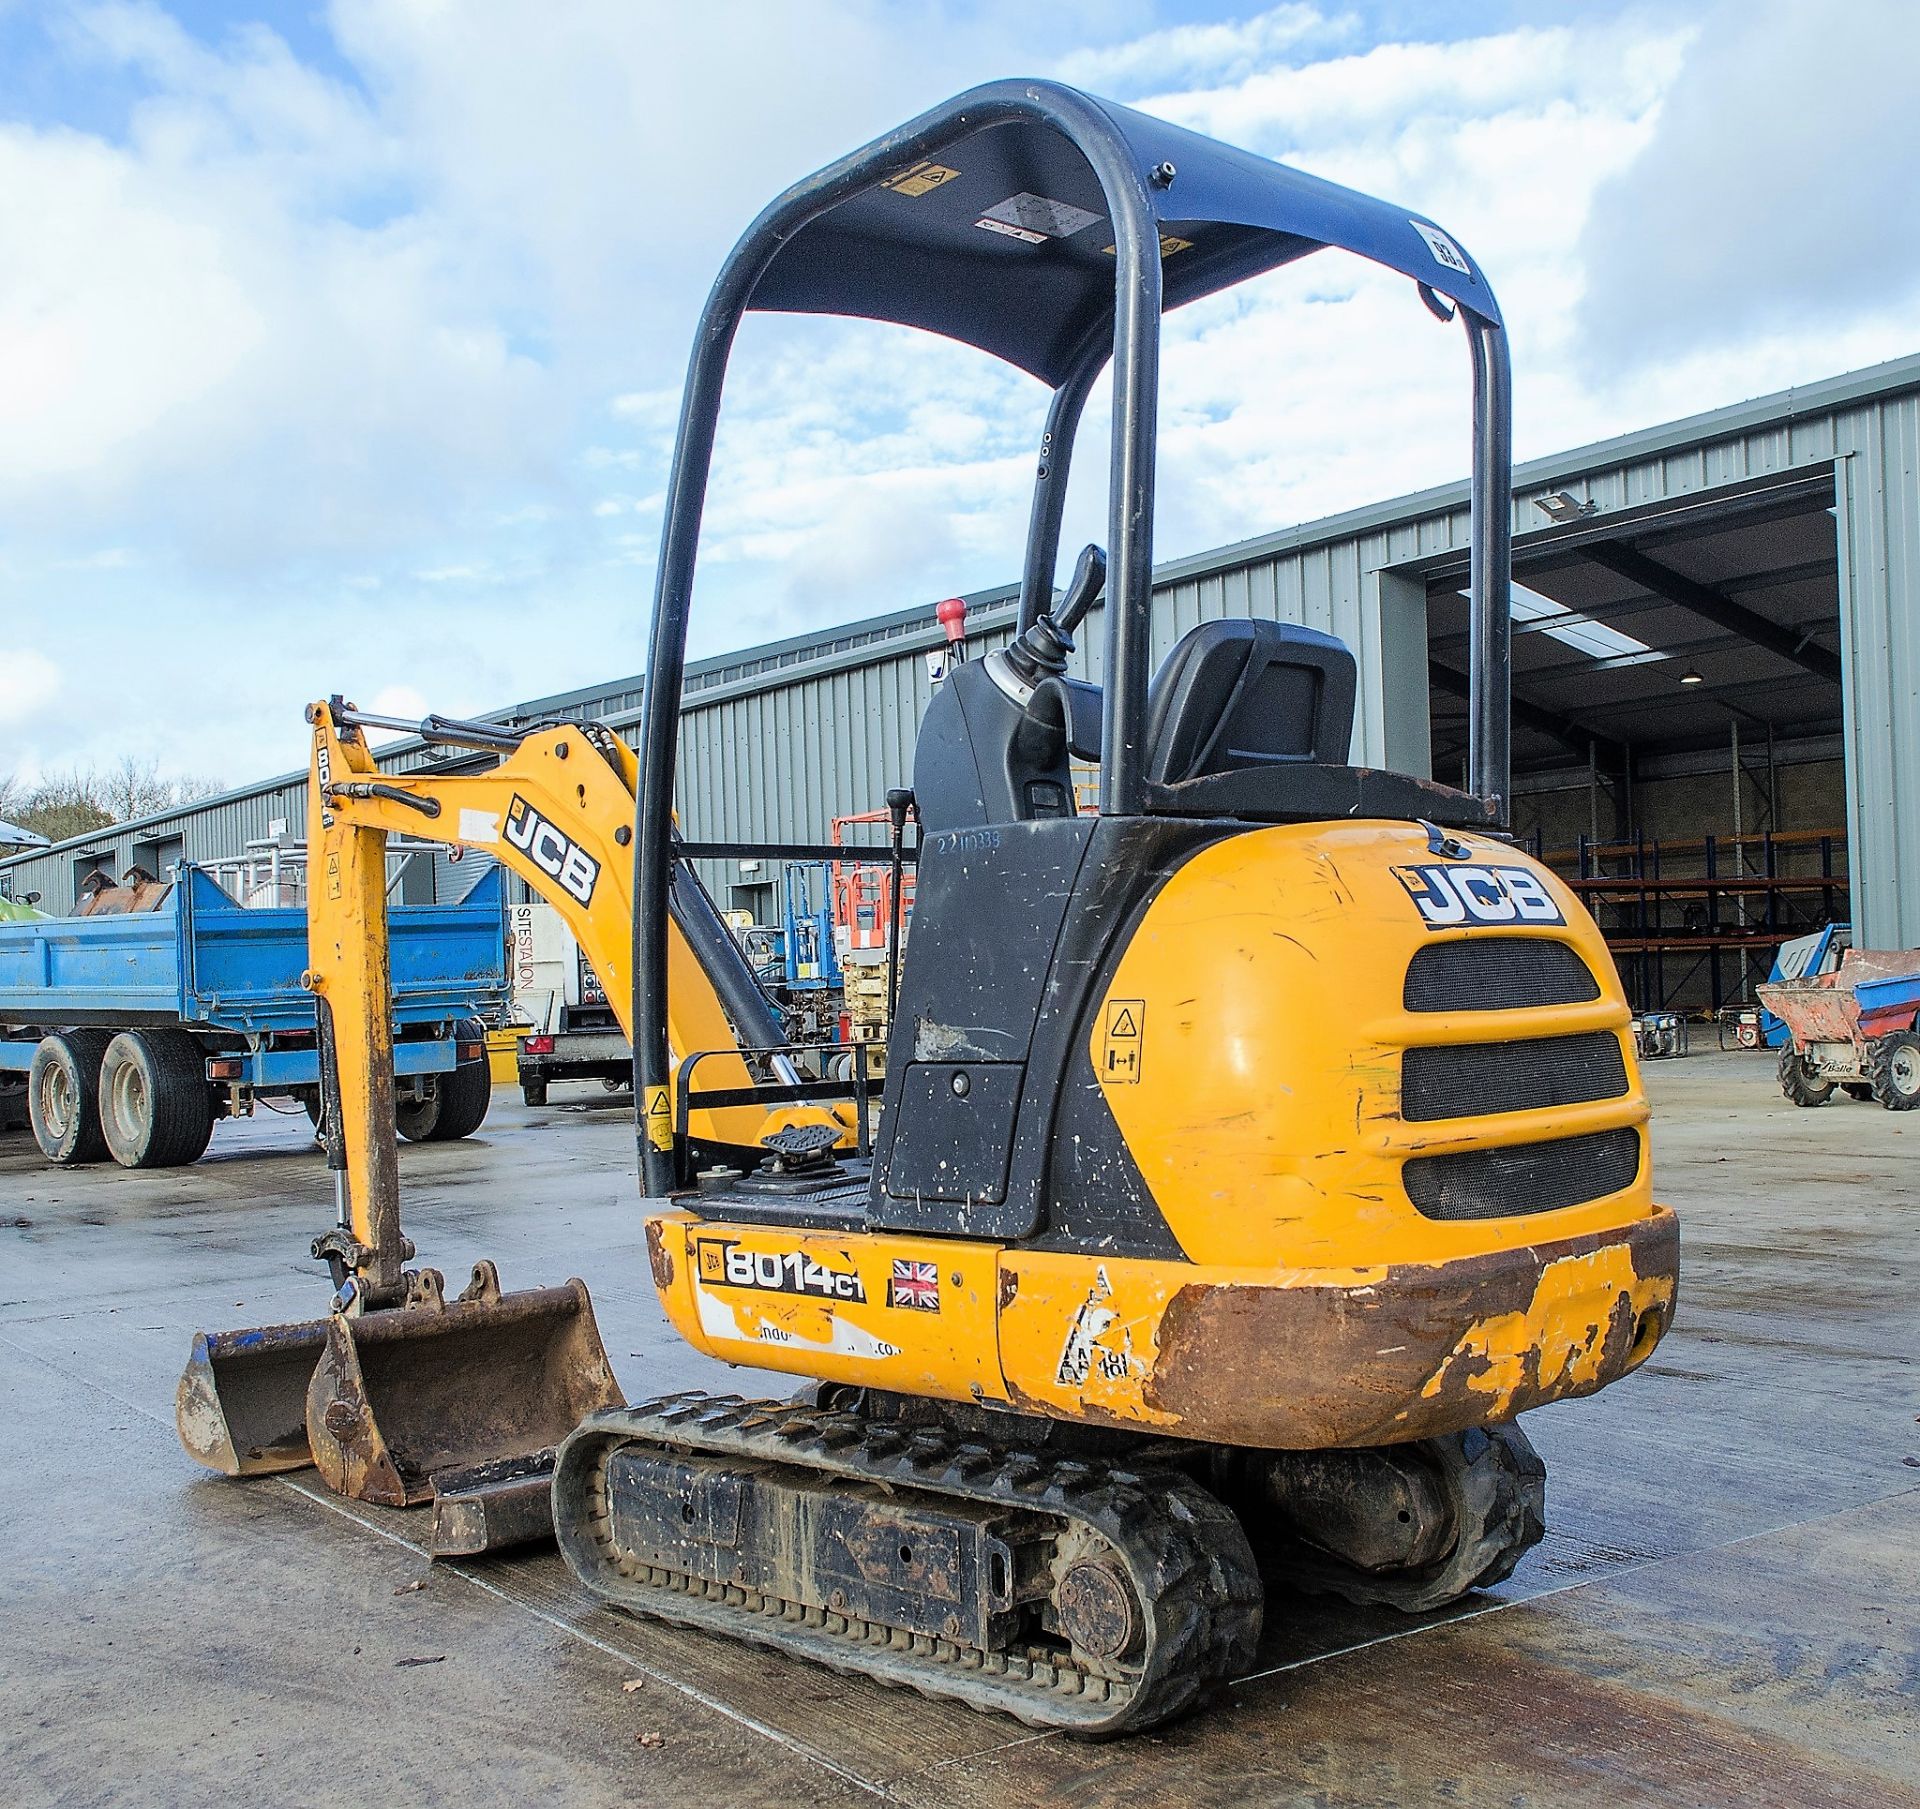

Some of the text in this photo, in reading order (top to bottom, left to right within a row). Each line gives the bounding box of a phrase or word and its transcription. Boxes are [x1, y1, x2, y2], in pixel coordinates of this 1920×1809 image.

[1432, 240, 1457, 266] 93
[506, 809, 597, 903] JCB
[1416, 867, 1560, 922] JCB
